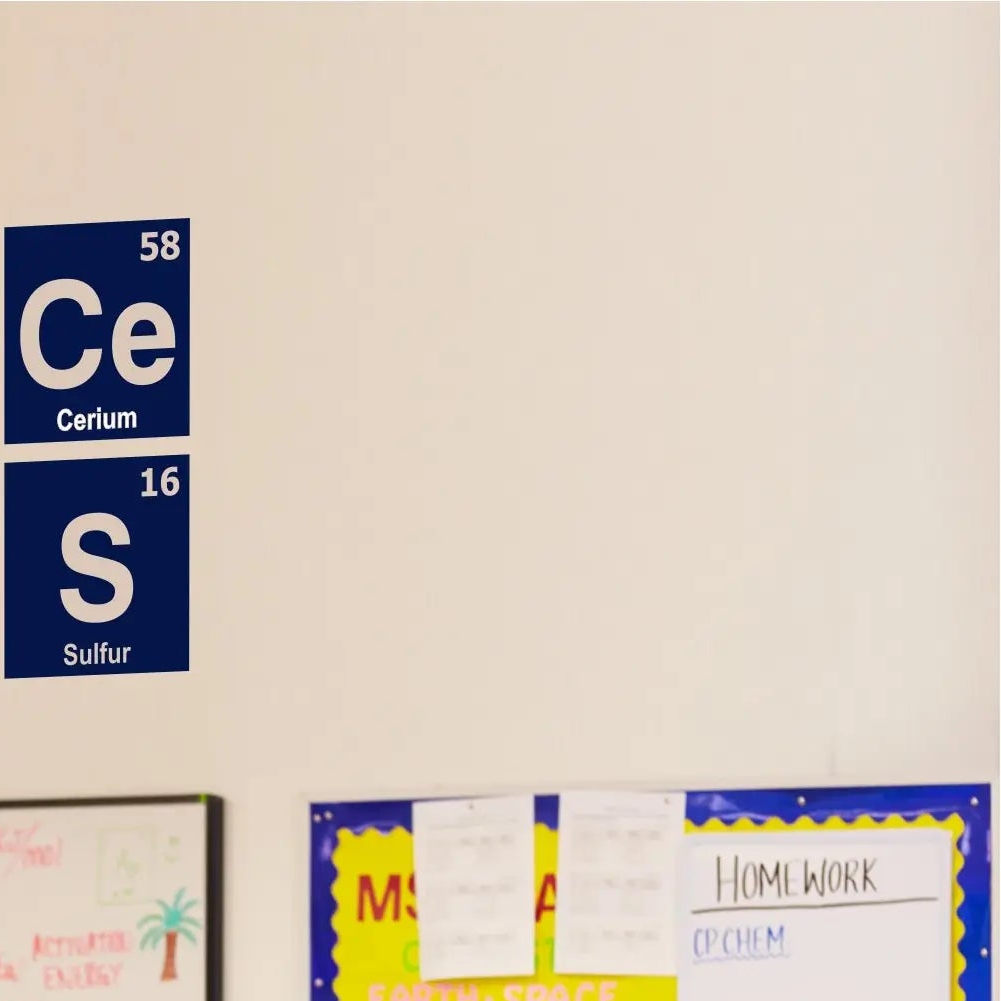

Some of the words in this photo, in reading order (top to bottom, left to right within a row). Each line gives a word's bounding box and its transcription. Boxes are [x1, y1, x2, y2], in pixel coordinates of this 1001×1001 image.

[140, 230, 181, 262] 58
[19, 278, 176, 390] Ce
[56, 406, 137, 432] Cerium
[141, 466, 180, 497] 16
[59, 512, 134, 624] S
[63, 641, 132, 666] Sulfur
[716, 854, 878, 904] HOMEWORK
